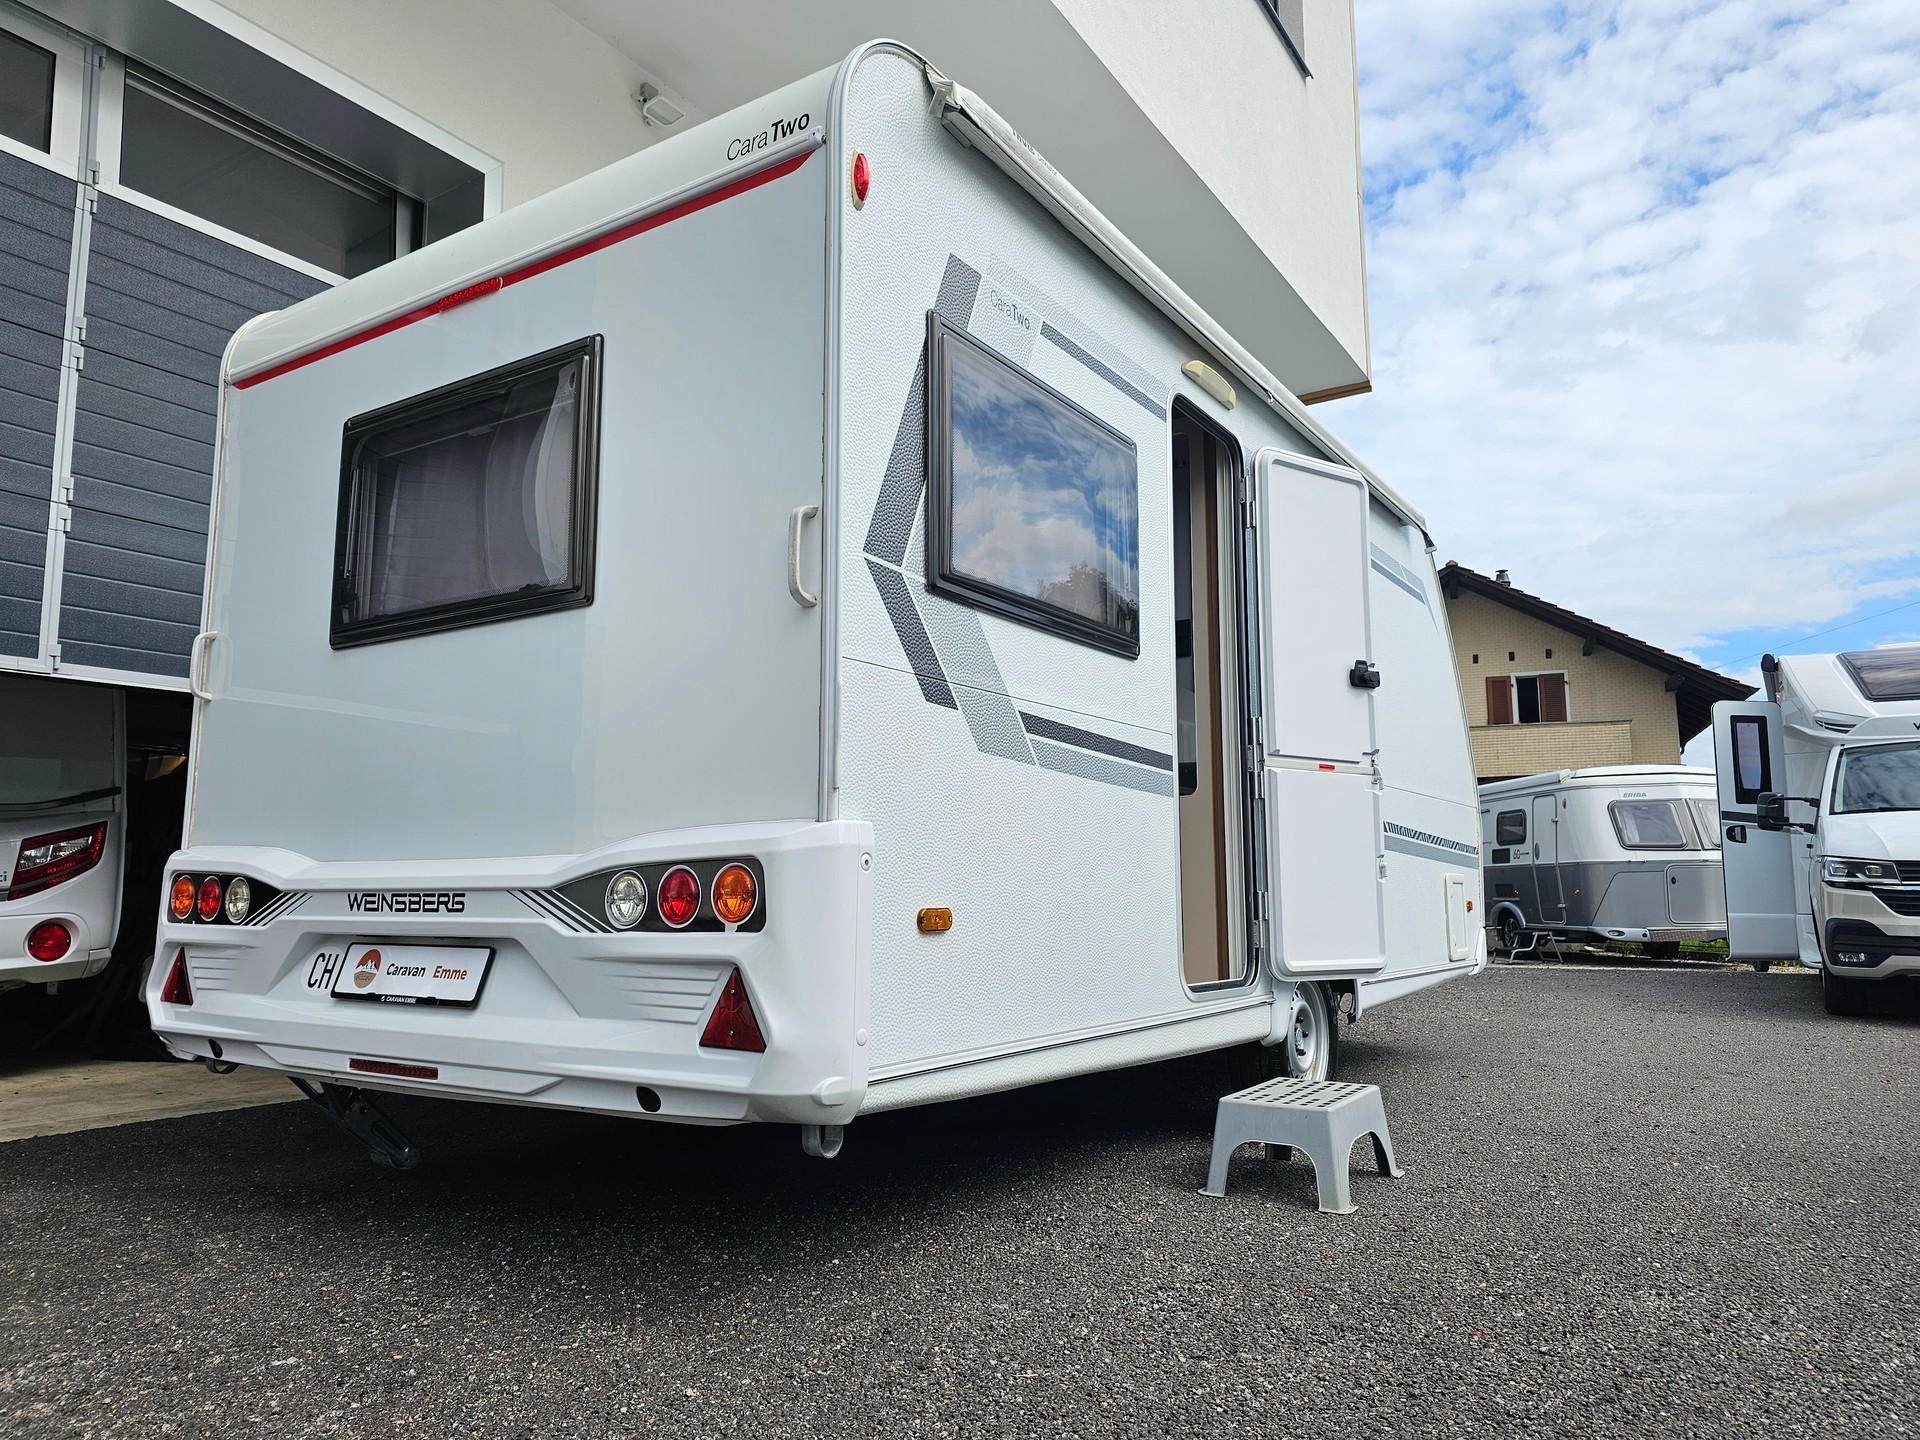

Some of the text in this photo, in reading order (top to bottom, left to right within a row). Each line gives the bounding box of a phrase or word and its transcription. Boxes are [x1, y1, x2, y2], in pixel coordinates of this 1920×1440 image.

[347, 892, 466, 912] WEINSBERG
[307, 952, 340, 989] CH
[386, 963, 426, 978] Caravan
[432, 965, 468, 981] Emme
